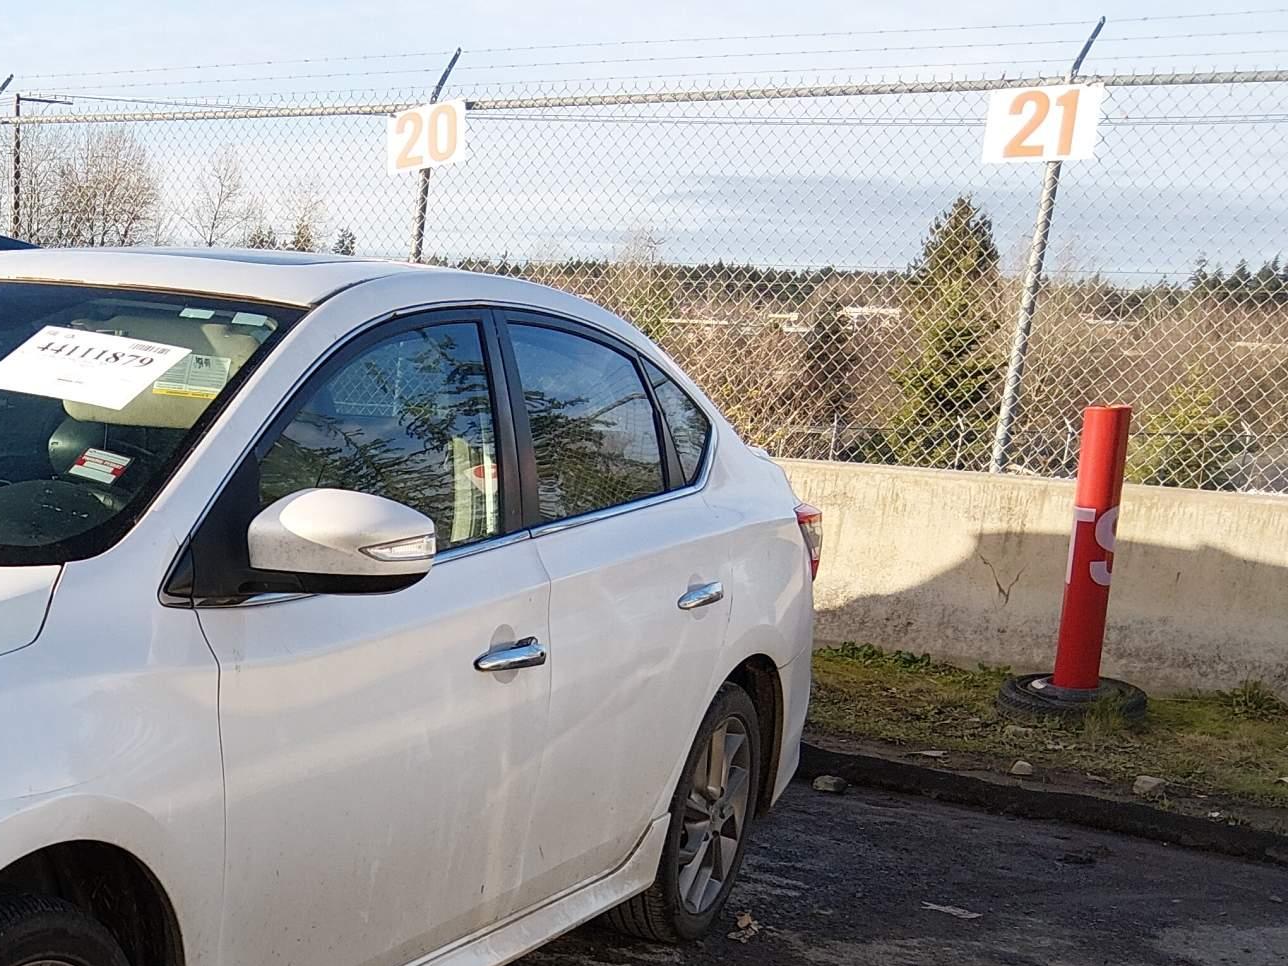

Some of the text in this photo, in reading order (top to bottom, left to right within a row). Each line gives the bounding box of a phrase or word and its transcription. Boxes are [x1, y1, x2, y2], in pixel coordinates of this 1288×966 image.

[395, 102, 459, 171] 20
[1003, 88, 1080, 159] 21
[36, 341, 155, 368] 44111879
